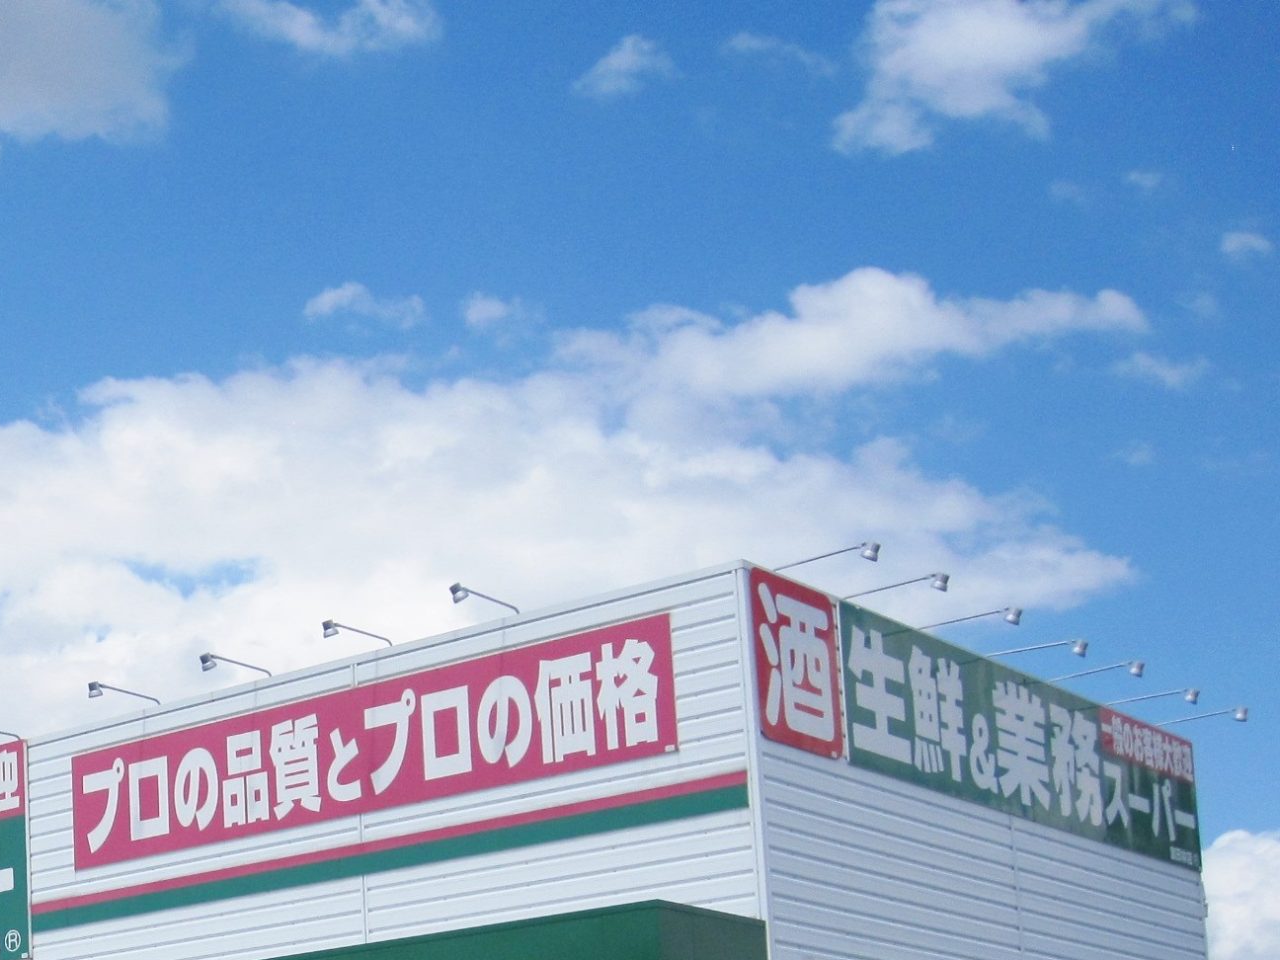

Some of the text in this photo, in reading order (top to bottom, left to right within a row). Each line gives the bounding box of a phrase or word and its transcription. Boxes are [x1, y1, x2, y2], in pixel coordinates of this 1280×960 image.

[81, 639, 659, 854] プロの品質とプロの価格
[757, 582, 836, 743] 酒
[847, 624, 1195, 841] 生鮮&業務スーパー
[1101, 715, 1193, 781] 一般のお客様大歓迎
